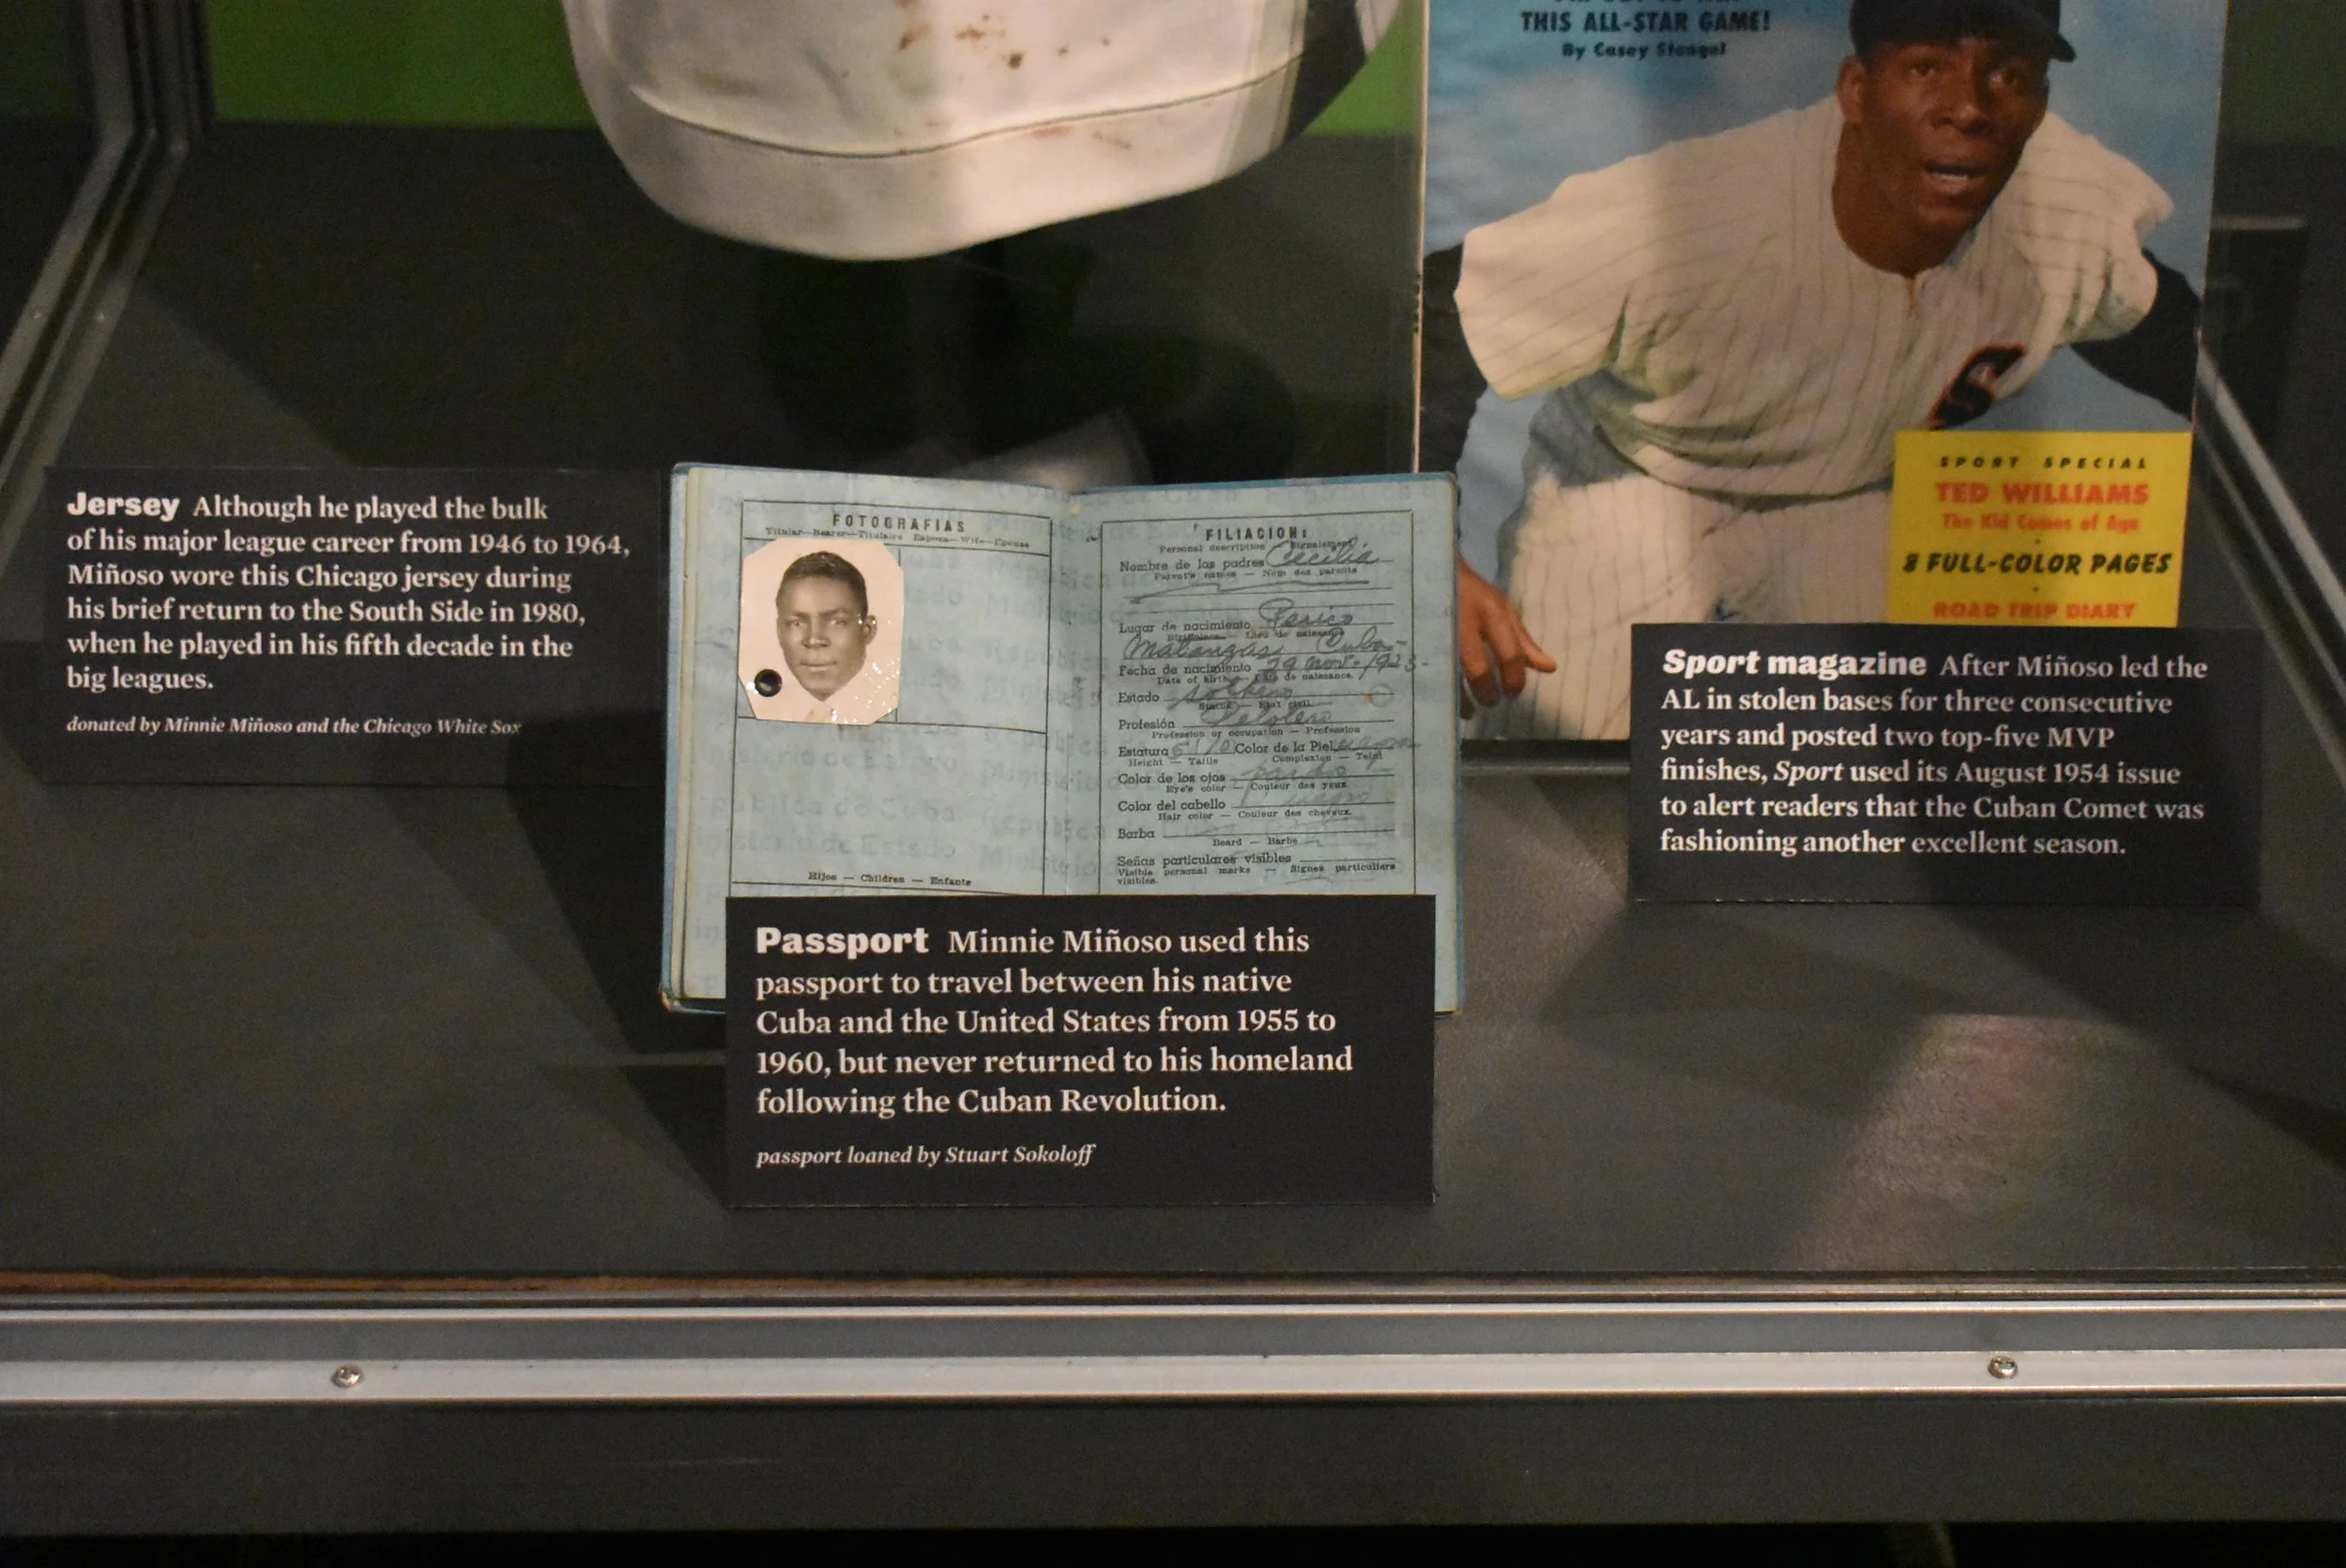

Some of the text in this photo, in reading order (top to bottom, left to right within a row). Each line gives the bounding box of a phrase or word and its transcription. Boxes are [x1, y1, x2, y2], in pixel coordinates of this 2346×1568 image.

[1520, 9, 1772, 33] THIS ALL-STAR GAME!
[1940, 456, 2147, 468] SPORT SPECIAL
[1935, 481, 2149, 505] TED WILLIAMS
[67, 491, 548, 525] Jersey Although he played the bulk
[832, 514, 966, 532] FOTOGRAFIAS
[1206, 527, 1307, 541] FILIACION:
[67, 526, 630, 557] of his major league career from 1946 to 1964,
[1902, 553, 2172, 574] 8 FULL-COLOR PAGES
[68, 562, 571, 594] Miñoso wore this Chicago jersey during
[68, 596, 586, 626] his brief return to the South Side in 1980,
[1932, 601, 2135, 619] ROAD TRIP DIARY
[1119, 622, 1154, 636] Lugar
[1183, 619, 1251, 632] nacimiento
[1662, 648, 2208, 681] Sport magazine After Miñoso led the
[67, 664, 214, 694] big leagues.
[1119, 693, 1160, 704] Estado
[1661, 686, 2172, 714] AL in stolen bases for three consecutive
[66, 715, 522, 738] donated by Minnie Miñoso and the Chicago White Sox
[1119, 718, 1175, 731] Profesión
[1660, 722, 2115, 753] years and posted two top-five MVP
[1119, 746, 1169, 757] Estatura
[1235, 742, 1269, 754] Color
[1273, 742, 1289, 754] de
[1293, 741, 1306, 753] la
[1310, 739, 1333, 752] Piel
[1660, 756, 2182, 788] finishes, Sport used its August 1954 issue
[1118, 798, 1226, 813] Color del cabello
[1660, 792, 2204, 820] to alert readers that the Cuban Comet was
[1118, 829, 1155, 840] Barba
[1660, 828, 2126, 858] fashioning another excellent season.
[1118, 852, 1292, 868] Señas particulares visibles
[756, 926, 1310, 960] Passport Minnie Miñoso used this
[755, 967, 1292, 1001] passport to travel between his native
[756, 1006, 1336, 1035] Cuba and the United States from 1955 to
[757, 1044, 1353, 1078] 1960, but never returned to his homeland
[756, 1085, 1226, 1119] following the Cuban Revolution.
[755, 1143, 1097, 1169] passport loaned by Stuart Sokoloff
